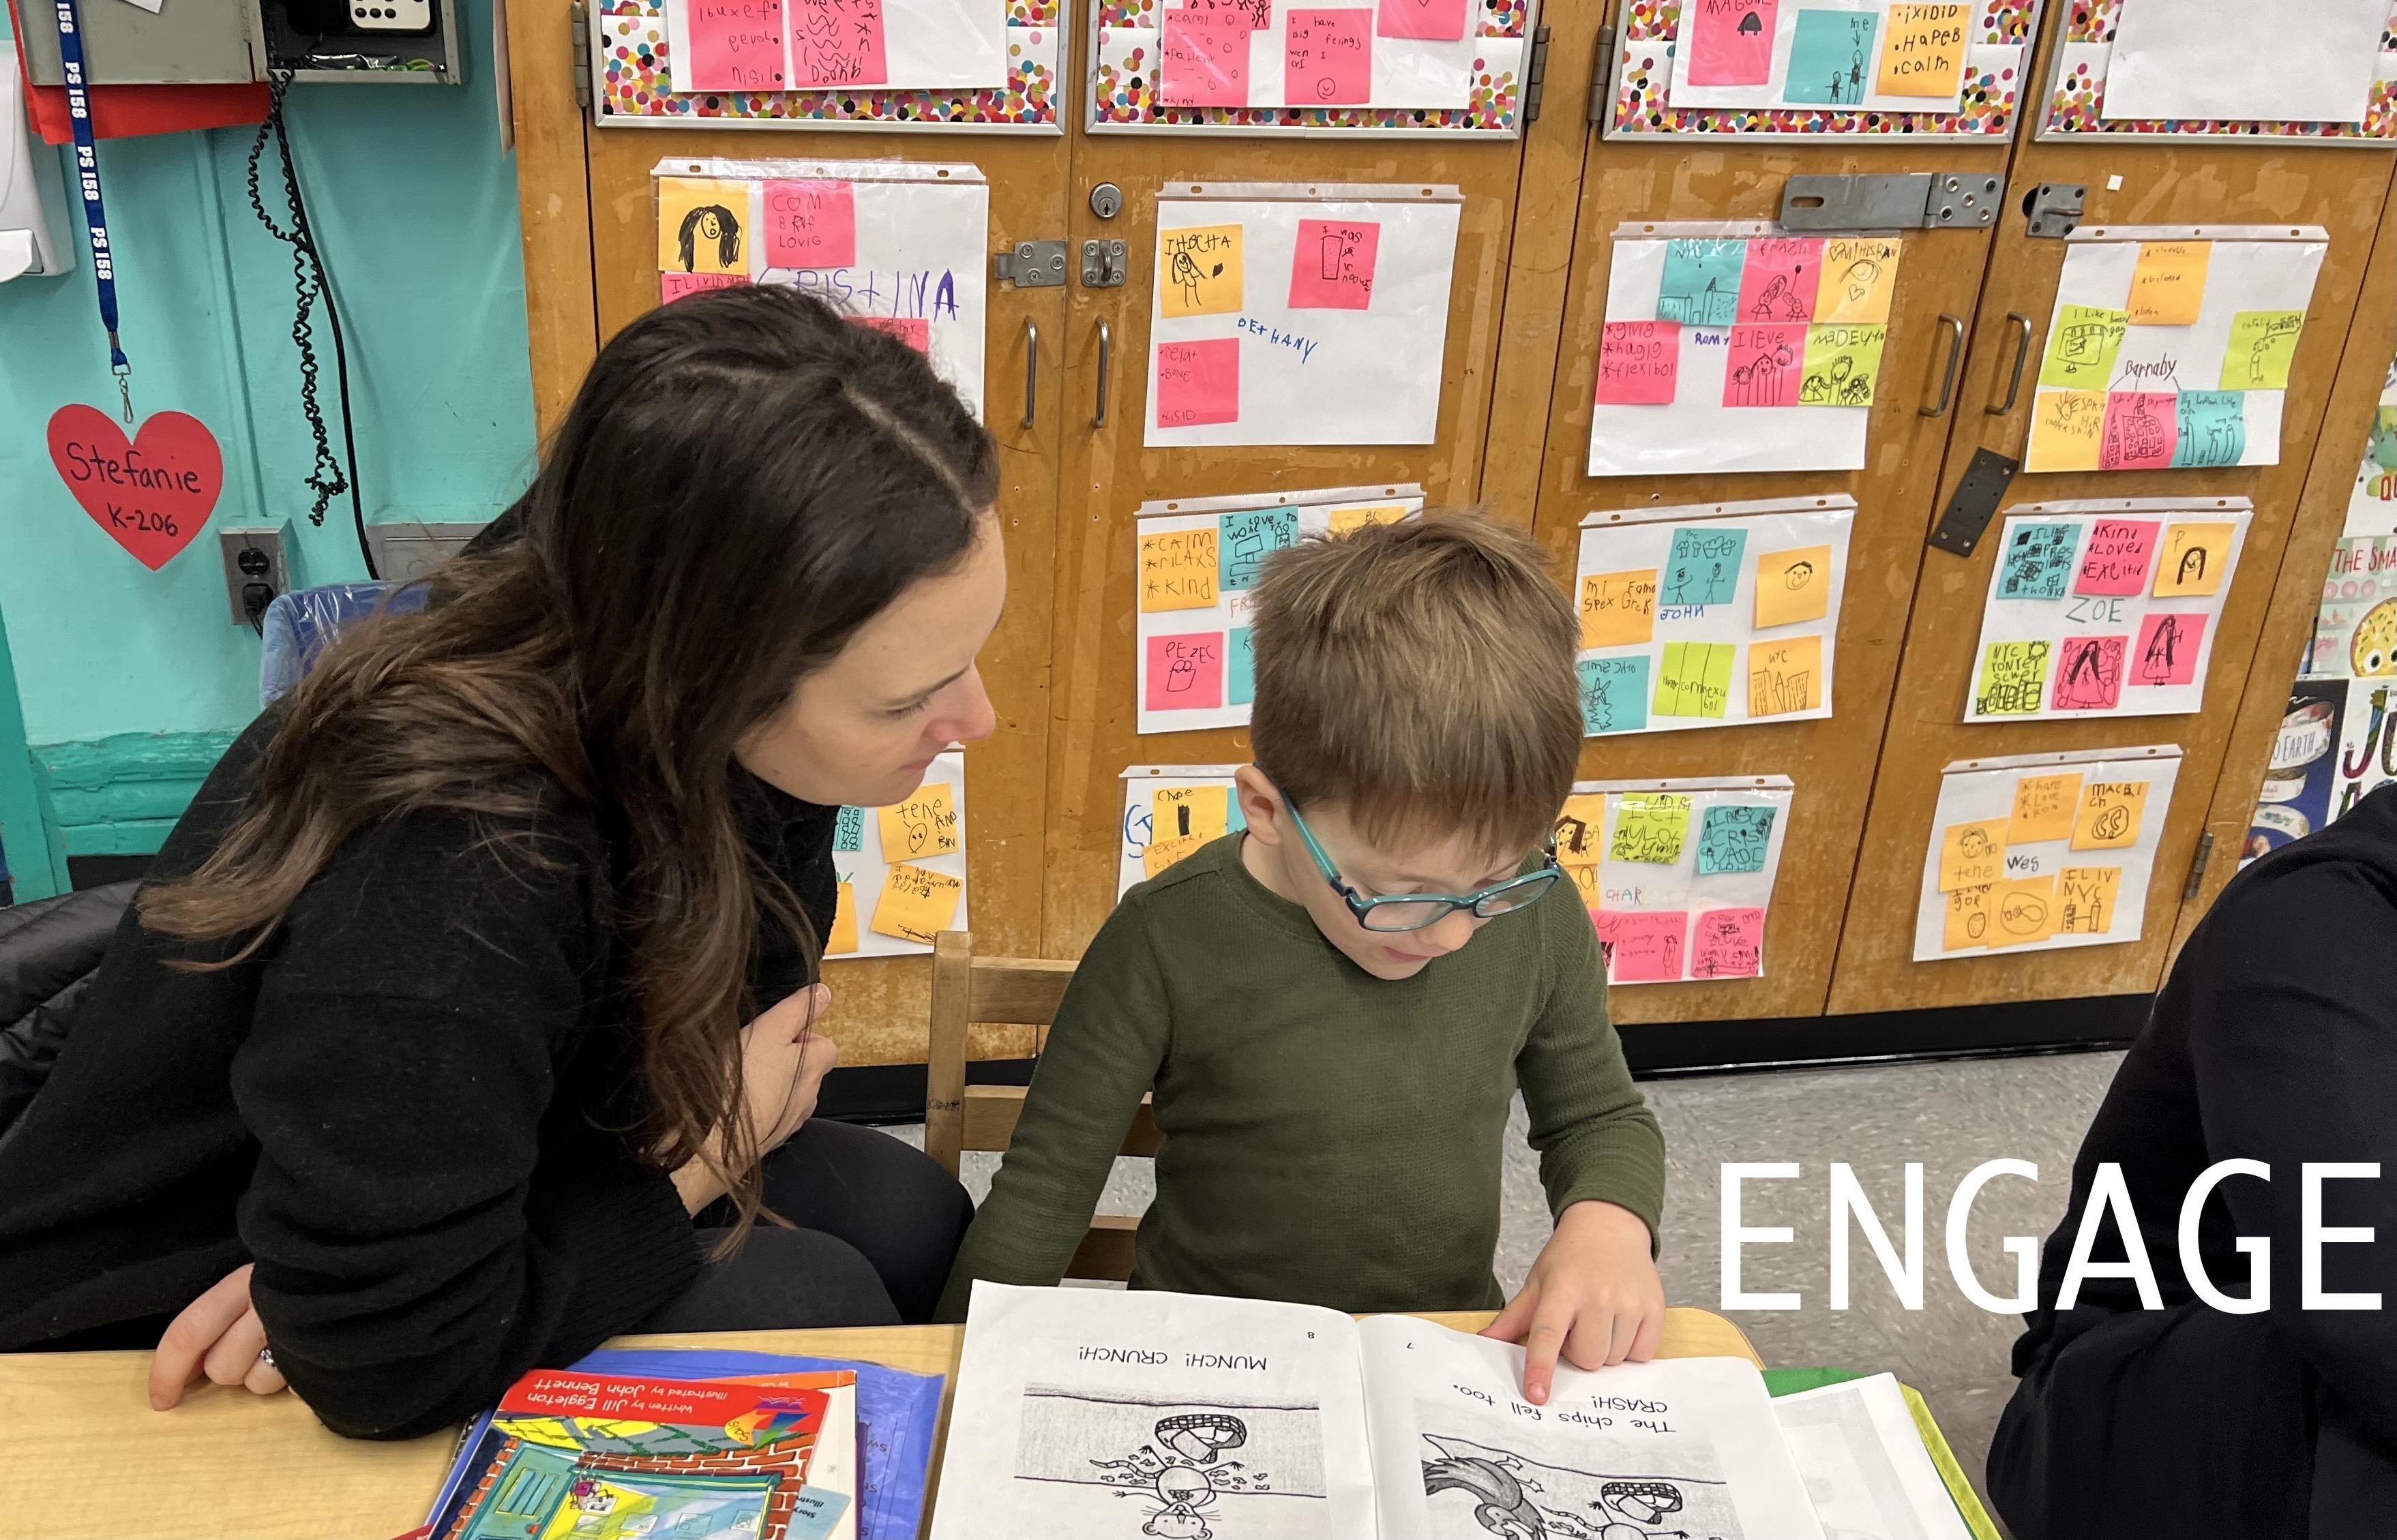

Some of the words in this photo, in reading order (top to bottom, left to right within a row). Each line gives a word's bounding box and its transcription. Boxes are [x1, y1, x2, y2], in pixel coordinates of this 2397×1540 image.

[57, 3, 74, 33] 158
[1850, 17, 1869, 31] me
[65, 61, 82, 85] PS
[68, 89, 87, 119] 158
[78, 145, 95, 168] PS
[81, 172, 100, 202] 158
[90, 227, 108, 248] PS
[94, 252, 113, 281] 158
[2125, 352, 2177, 381] Barnaby
[66, 442, 202, 494] Stefanie
[106, 502, 179, 537] K-206
[2334, 548, 2365, 574] THE
[2065, 595, 2126, 624] ZOE
[2282, 730, 2317, 761] EARTH
[1307, 1331, 1315, 1340] 8
[1079, 1346, 1168, 1365] CRUNCH!
[1185, 1353, 1267, 1371] MUNCH!
[534, 1378, 601, 1393] Bennett
[606, 1383, 646, 1398] John
[651, 1386, 665, 1397] by
[668, 1387, 728, 1400] Illustrated
[1452, 1383, 1496, 1407] too.
[526, 1392, 597, 1410] Eggleton
[602, 1396, 629, 1412] Jill
[631, 1398, 645, 1409] by
[649, 1399, 693, 1414] Written
[1510, 1401, 1543, 1421] fell
[1592, 1395, 1668, 1414] CRASH!
[728, 1419, 750, 1443] Sails
[1558, 1412, 1613, 1431] chips
[1631, 1418, 1677, 1434] The
